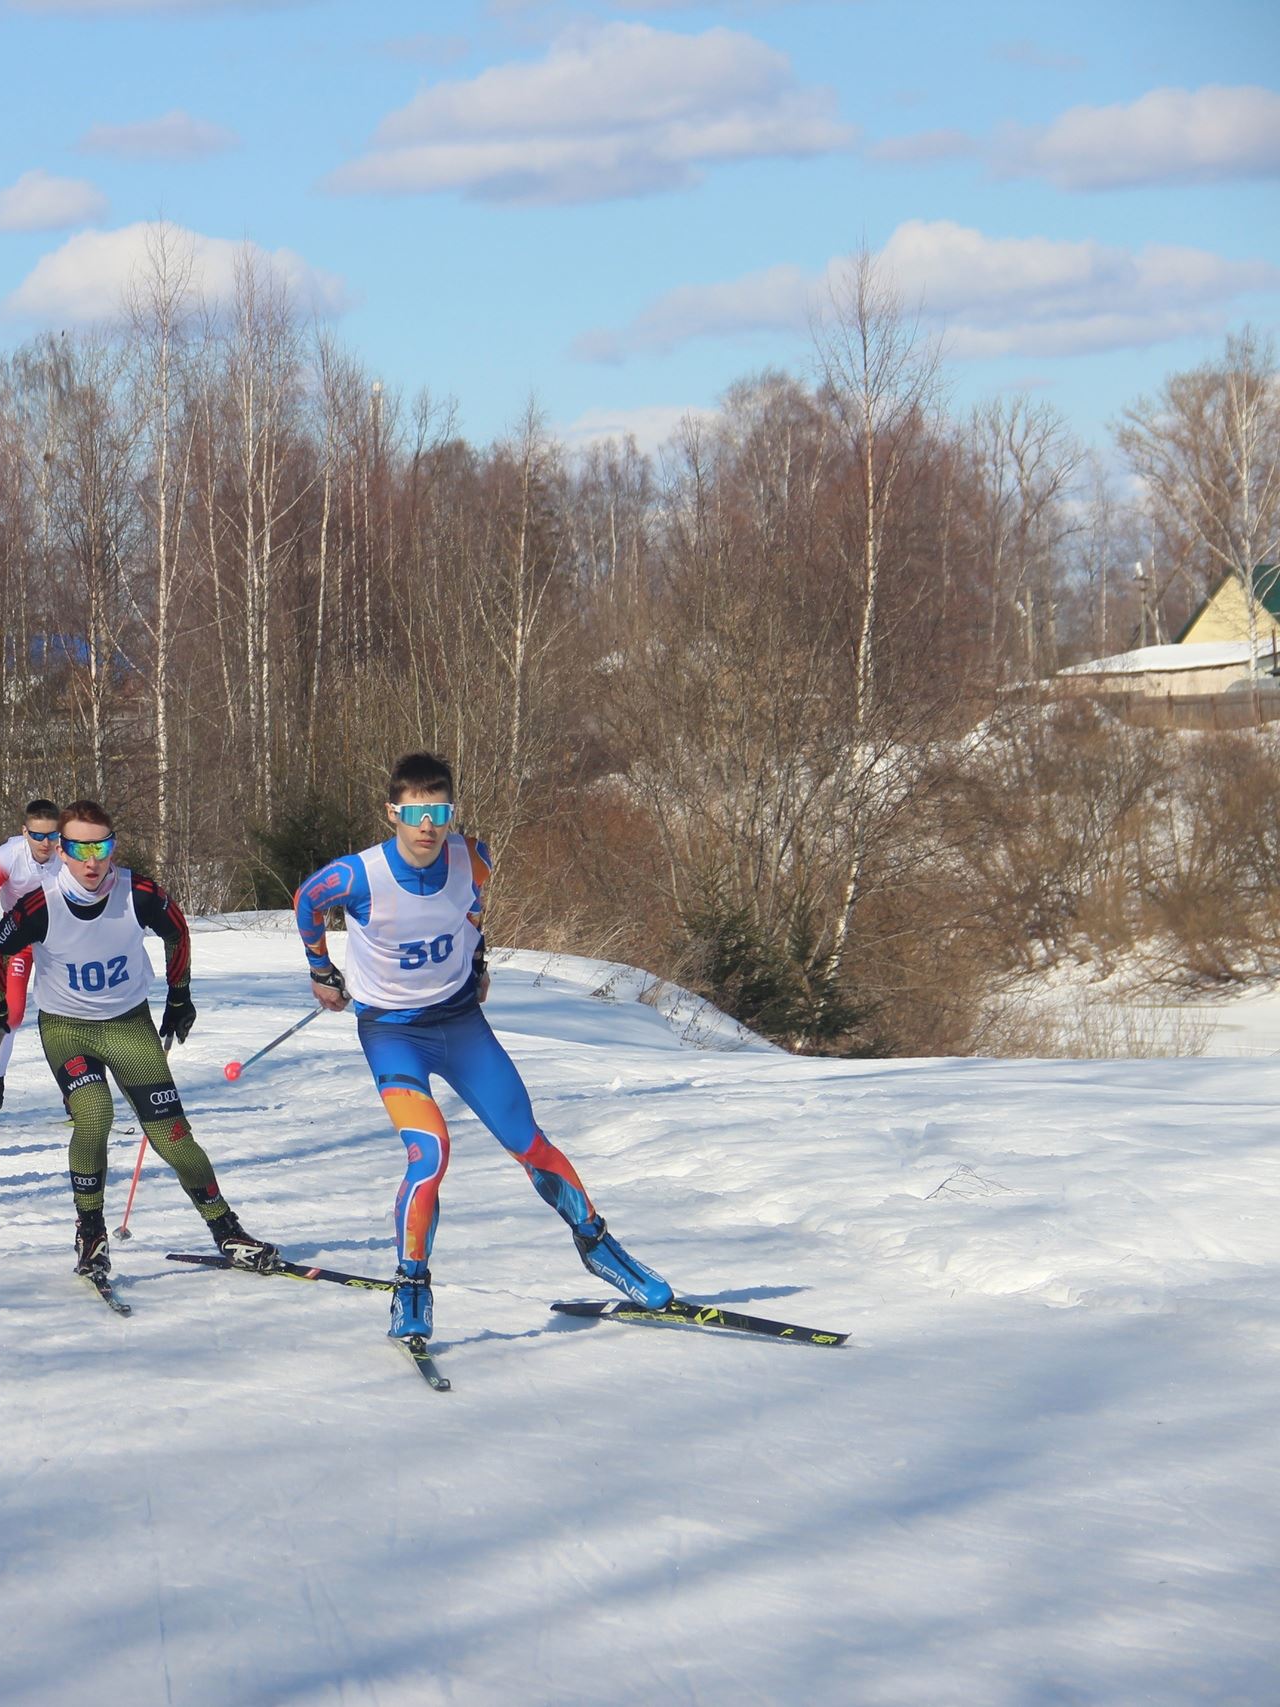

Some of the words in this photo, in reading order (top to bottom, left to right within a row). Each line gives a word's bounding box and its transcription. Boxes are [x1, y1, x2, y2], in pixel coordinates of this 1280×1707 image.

[399, 934, 454, 970] 30
[66, 955, 130, 992] 102
[592, 1258, 648, 1305] SPINE
[618, 1312, 687, 1324] FISCHER
